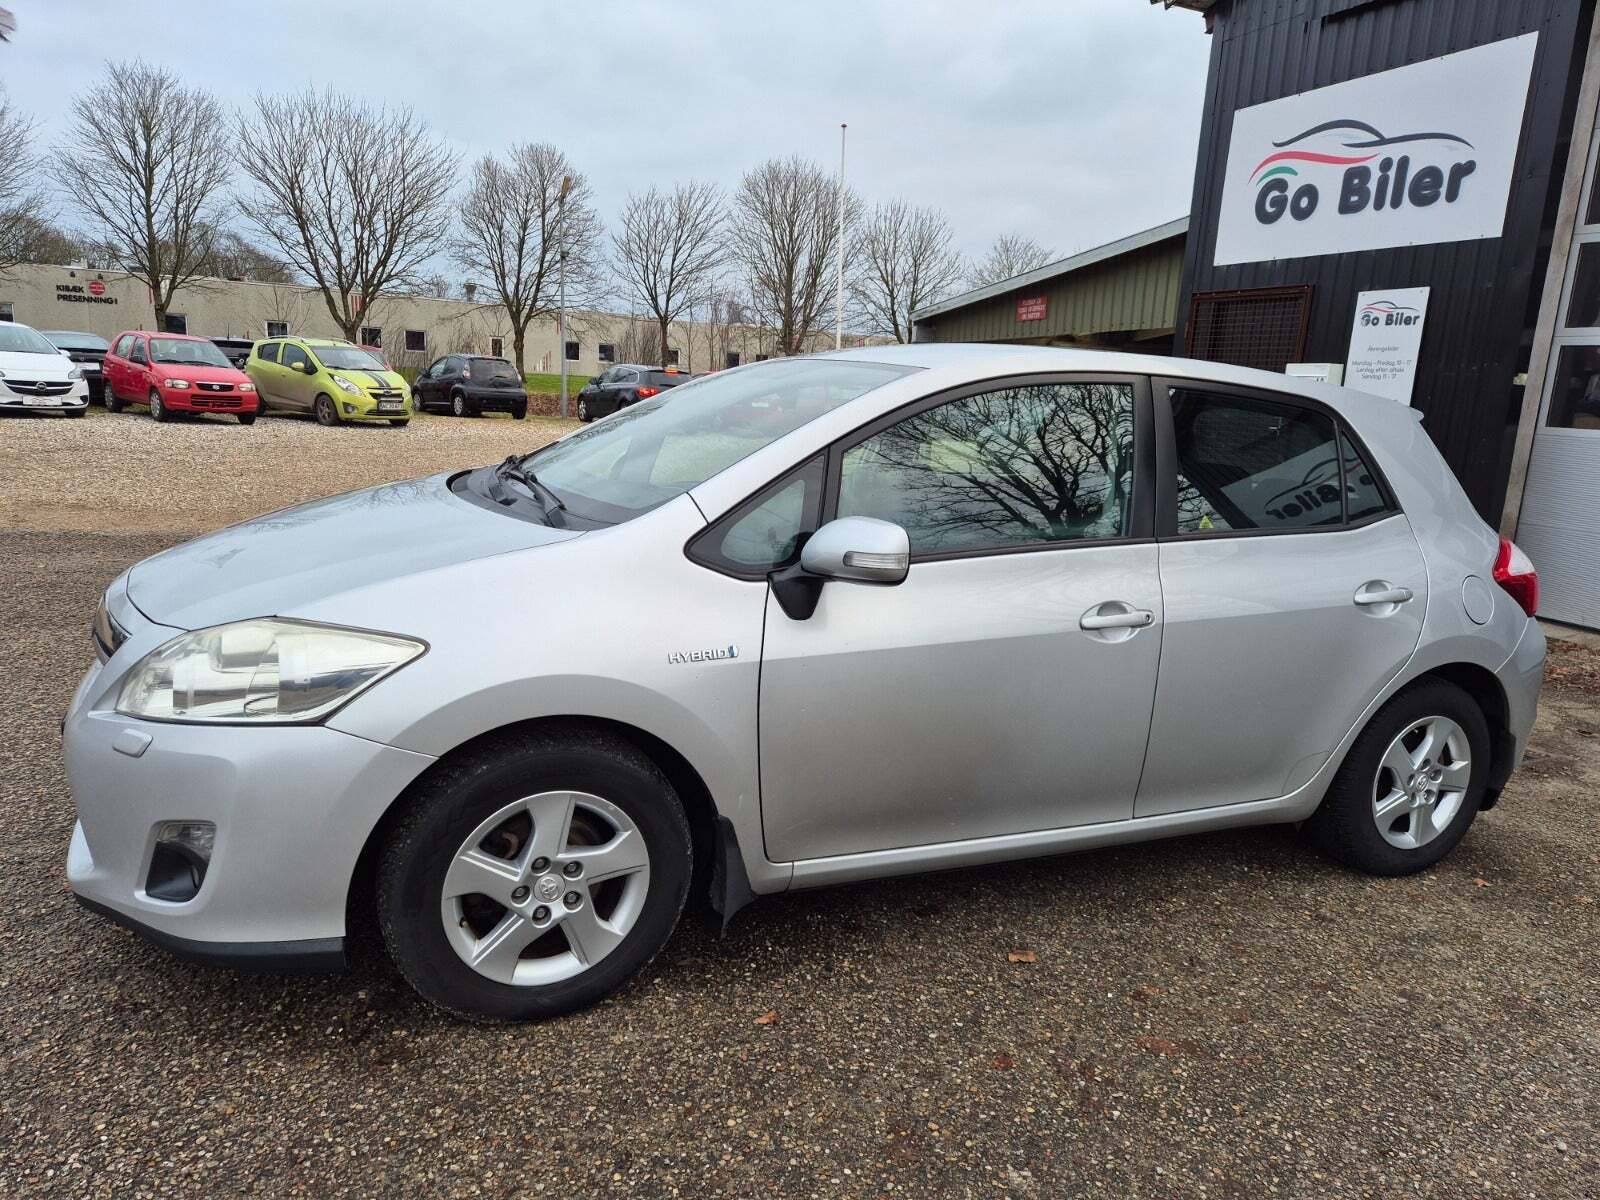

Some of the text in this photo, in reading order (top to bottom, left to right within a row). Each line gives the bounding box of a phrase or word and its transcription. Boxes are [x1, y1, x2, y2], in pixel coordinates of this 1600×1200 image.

[1254, 154, 1477, 225] Go Biler
[1360, 312, 1421, 327] Go Biler
[667, 648, 727, 664] HYBRID
